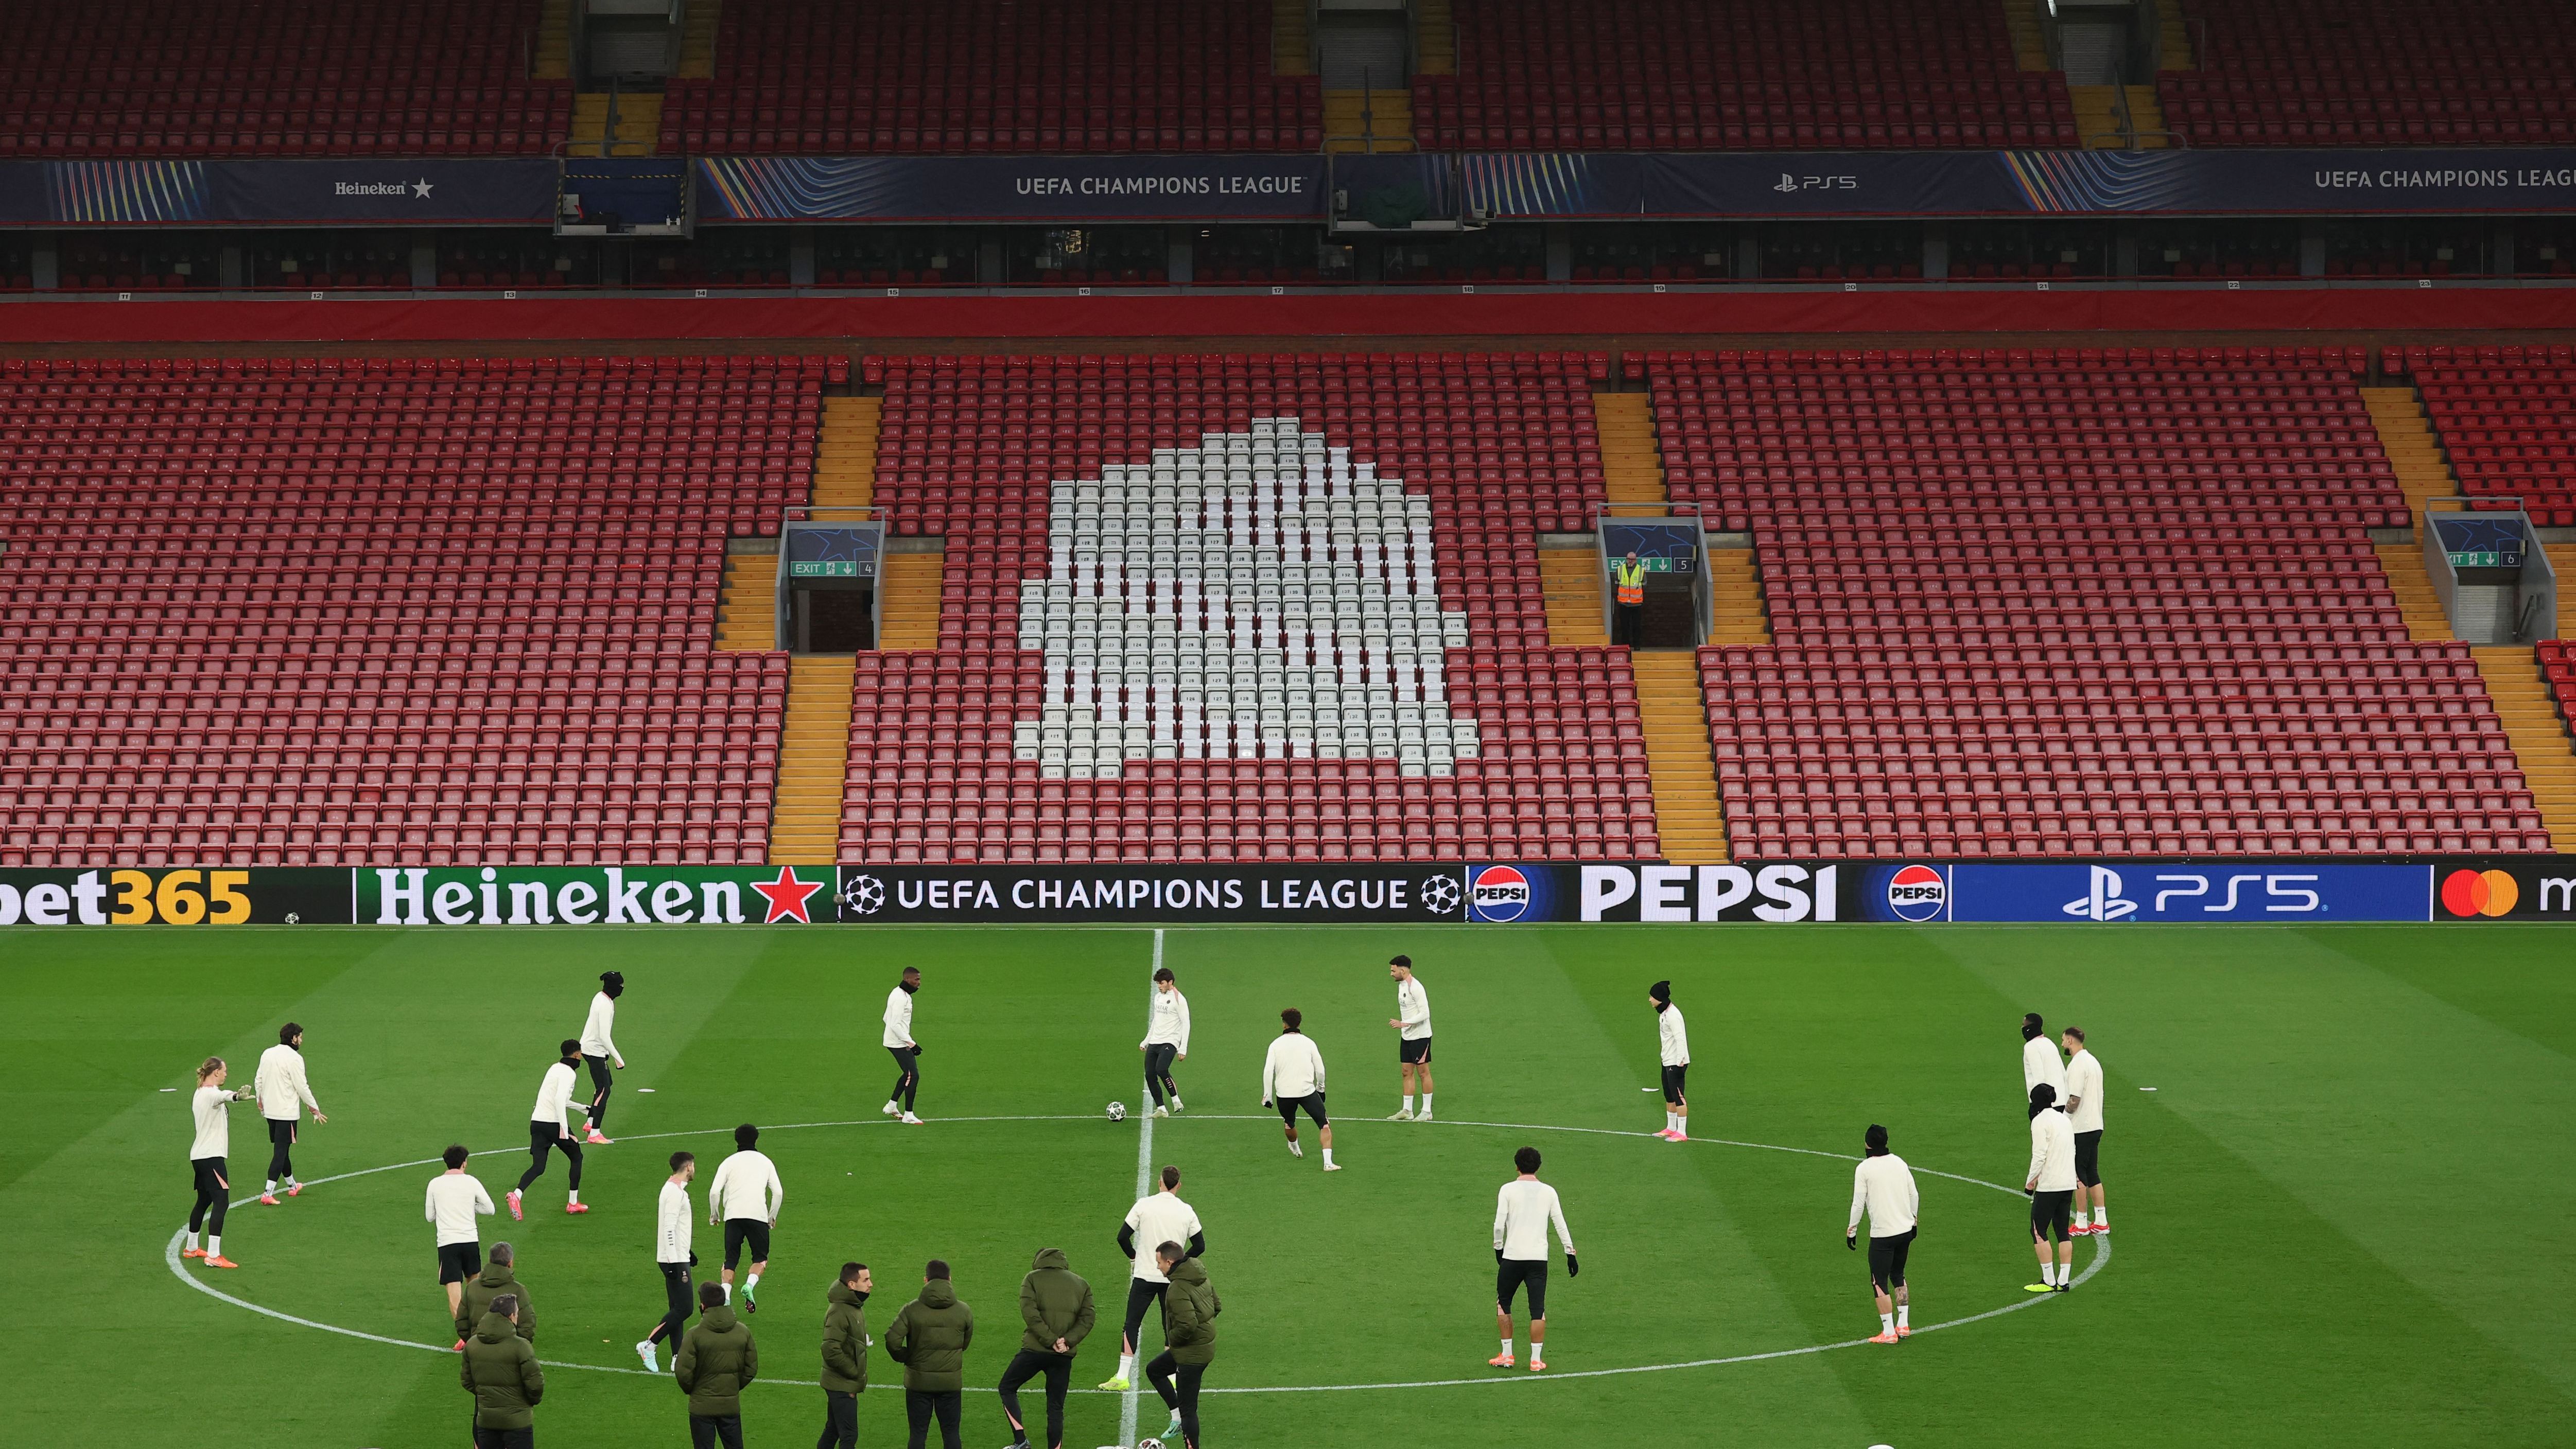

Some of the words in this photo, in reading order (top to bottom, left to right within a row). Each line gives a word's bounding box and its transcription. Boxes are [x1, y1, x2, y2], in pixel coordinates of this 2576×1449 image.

[1803, 176, 1857, 189] PS5
[2316, 171, 2373, 187] UEFA
[2379, 169, 2508, 187] CHAMPIONS
[2518, 169, 2576, 186] LEAG
[335, 181, 406, 195] Heineken
[1017, 178, 1073, 195] UEFA
[1080, 177, 1210, 194] CHAMPIONS
[1220, 177, 1302, 194] LEAGUE
[1611, 560, 1625, 569] EX
[1681, 560, 1687, 570] 5
[2507, 554, 2514, 564] 6
[795, 564, 821, 573] EXIT
[864, 564, 873, 573] 4
[375, 867, 745, 924] Heineken
[897, 880, 1000, 909] UEFA
[1012, 879, 1243, 909] CHAMPIONS
[1260, 879, 1408, 909] LEAGUE
[1475, 887, 1526, 900] PEPSI
[1580, 865, 1837, 922] PEPSI
[1891, 887, 1942, 900] PEPSI
[2155, 875, 2320, 911] PS5
